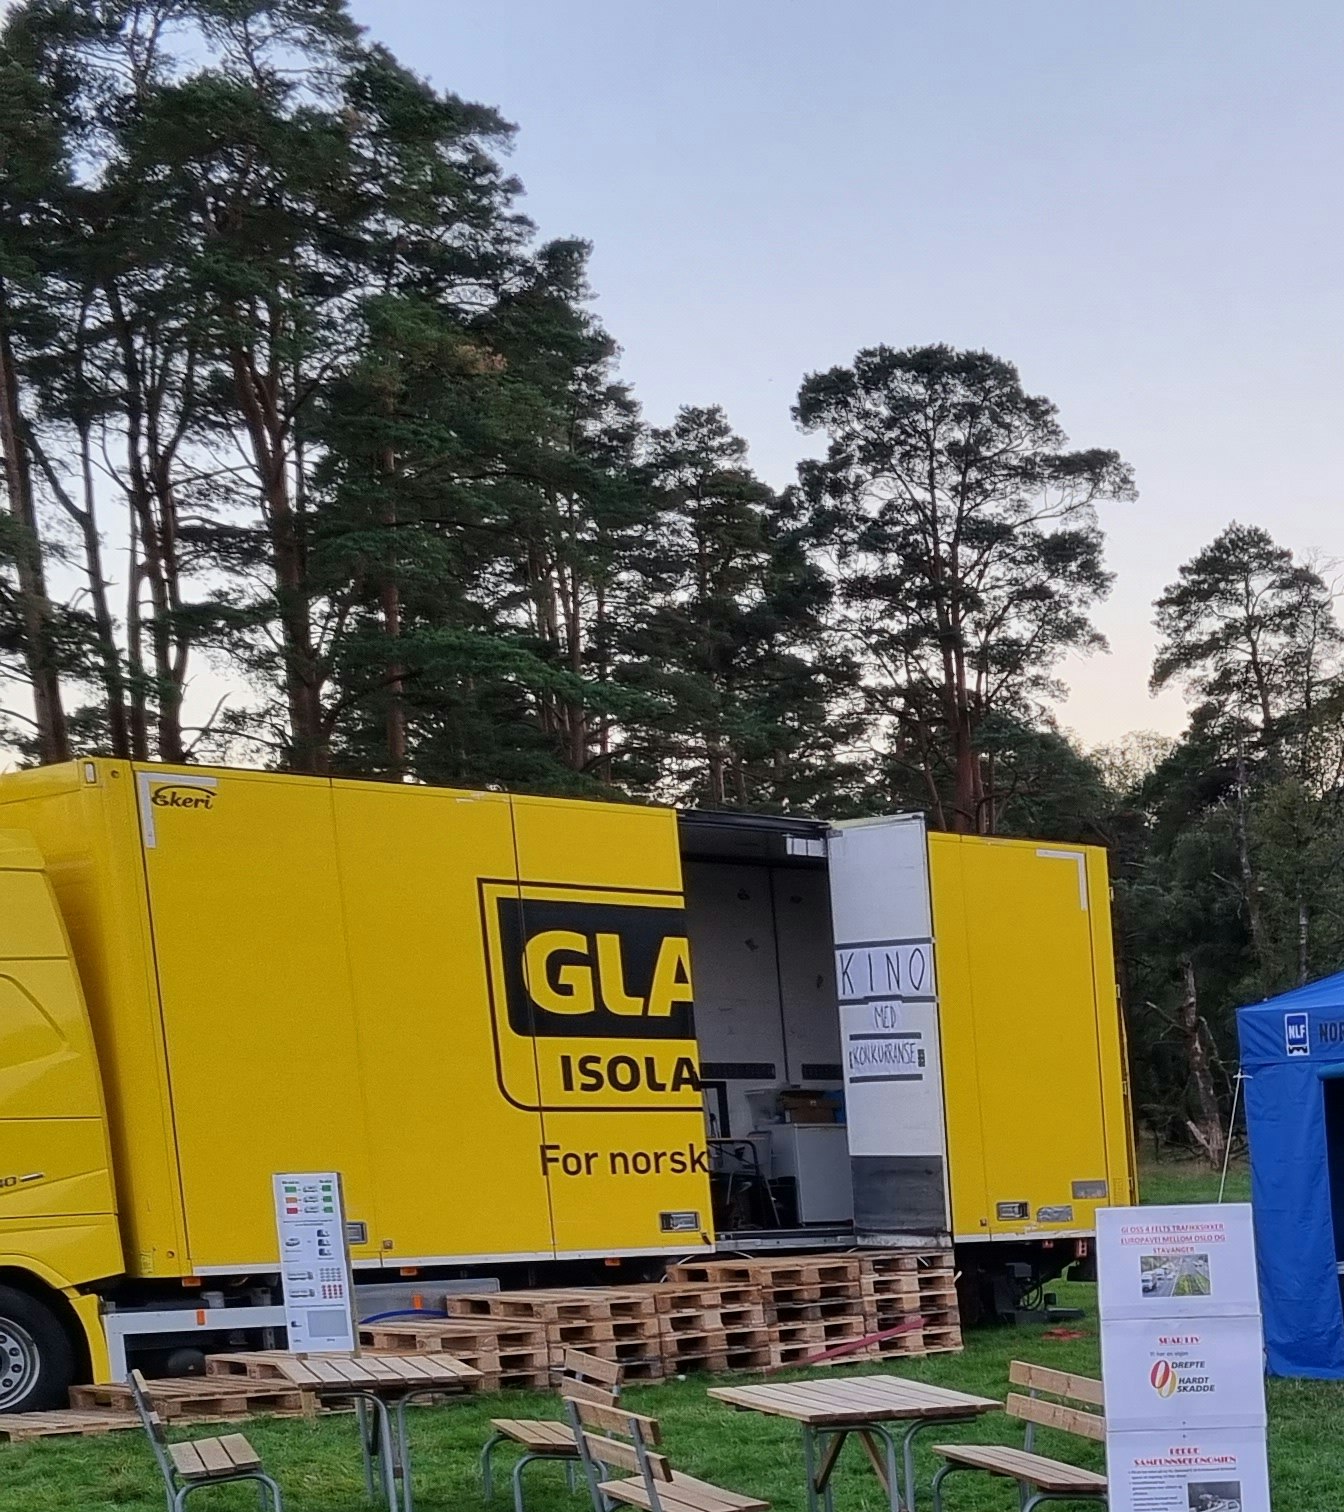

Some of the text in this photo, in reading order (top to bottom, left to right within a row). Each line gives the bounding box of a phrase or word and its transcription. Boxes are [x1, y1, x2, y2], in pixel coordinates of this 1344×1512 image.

[152, 785, 217, 810] Ekeri
[840, 948, 925, 995] KINO
[874, 1005, 897, 1028] MED
[1288, 1025, 1306, 1039] NLF
[850, 1043, 916, 1067] KONKURRANSE
[561, 1055, 701, 1092] ISOLA
[540, 1143, 708, 1176] For norsk
[1153, 1246, 1194, 1254] STAVANGER
[1178, 1376, 1209, 1384] HARDT
